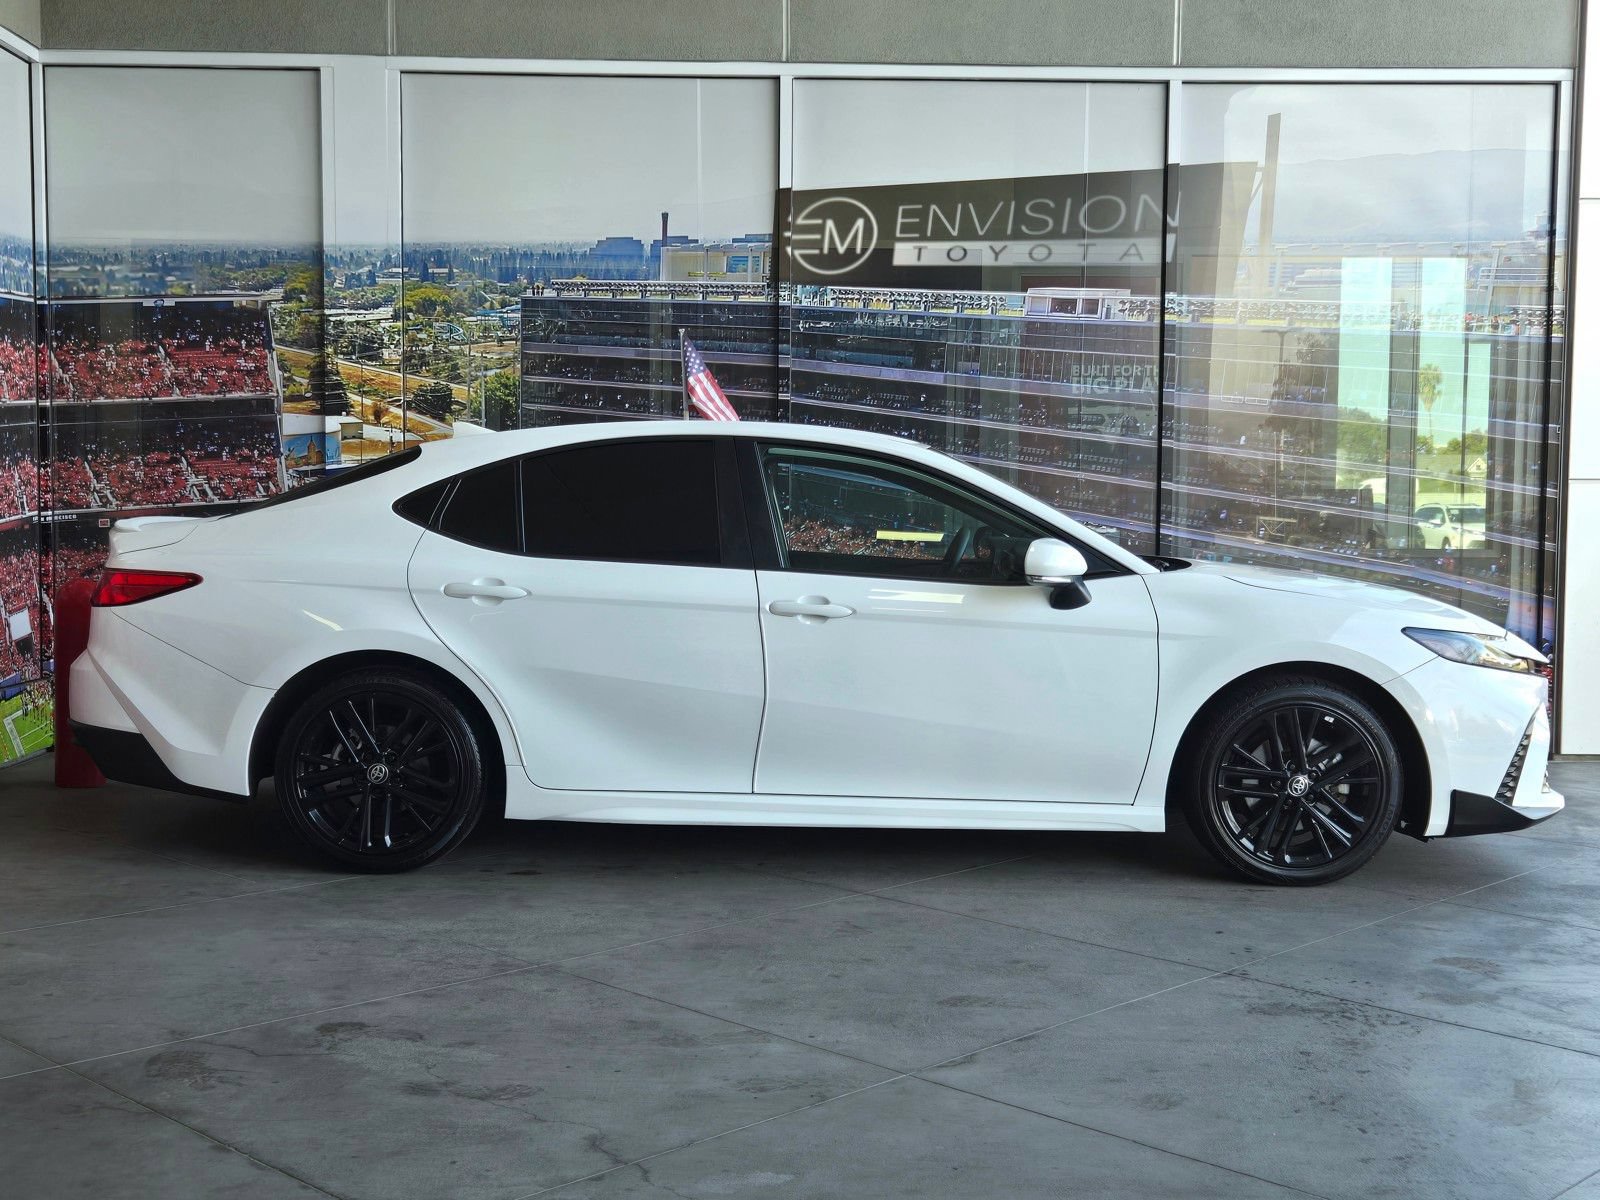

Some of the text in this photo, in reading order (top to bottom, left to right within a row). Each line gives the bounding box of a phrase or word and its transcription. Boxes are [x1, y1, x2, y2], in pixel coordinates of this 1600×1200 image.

[895, 191, 1181, 238] ENVISION
[912, 243, 1144, 262] TOYOTA
[1072, 364, 1111, 377] BUILT
[1114, 364, 1141, 376] FOR
